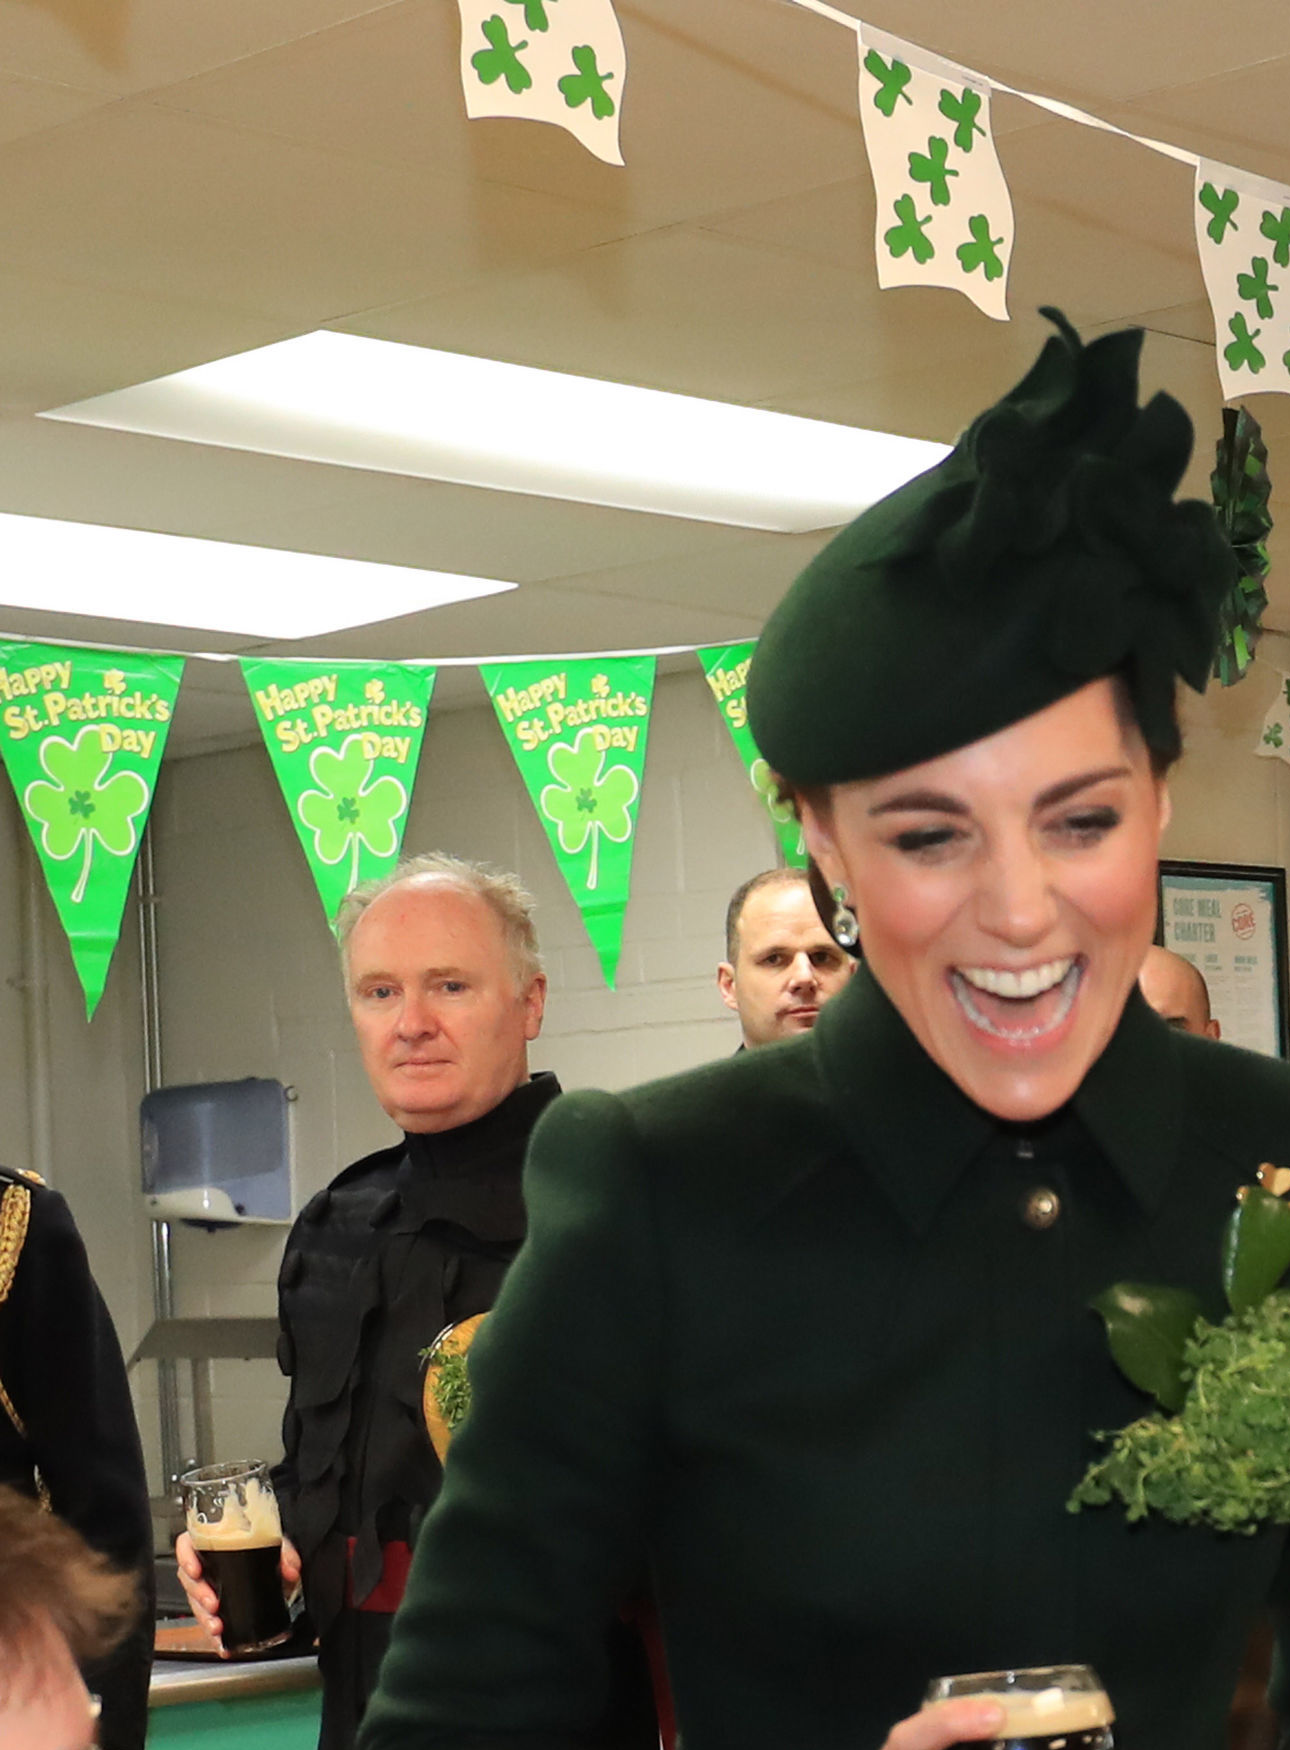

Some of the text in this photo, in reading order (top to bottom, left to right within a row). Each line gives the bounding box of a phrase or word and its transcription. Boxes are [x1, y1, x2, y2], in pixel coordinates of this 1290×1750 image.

[42, 691, 171, 727] Patrick's
[255, 673, 338, 722] Happy
[496, 672, 566, 722] Happy
[546, 690, 647, 735] Patrick's
[311, 699, 423, 738] Patrick's
[99, 722, 156, 759] Day
[360, 731, 411, 764] Day
[592, 723, 639, 752] Day
[1174, 921, 1216, 943] CHARTER
